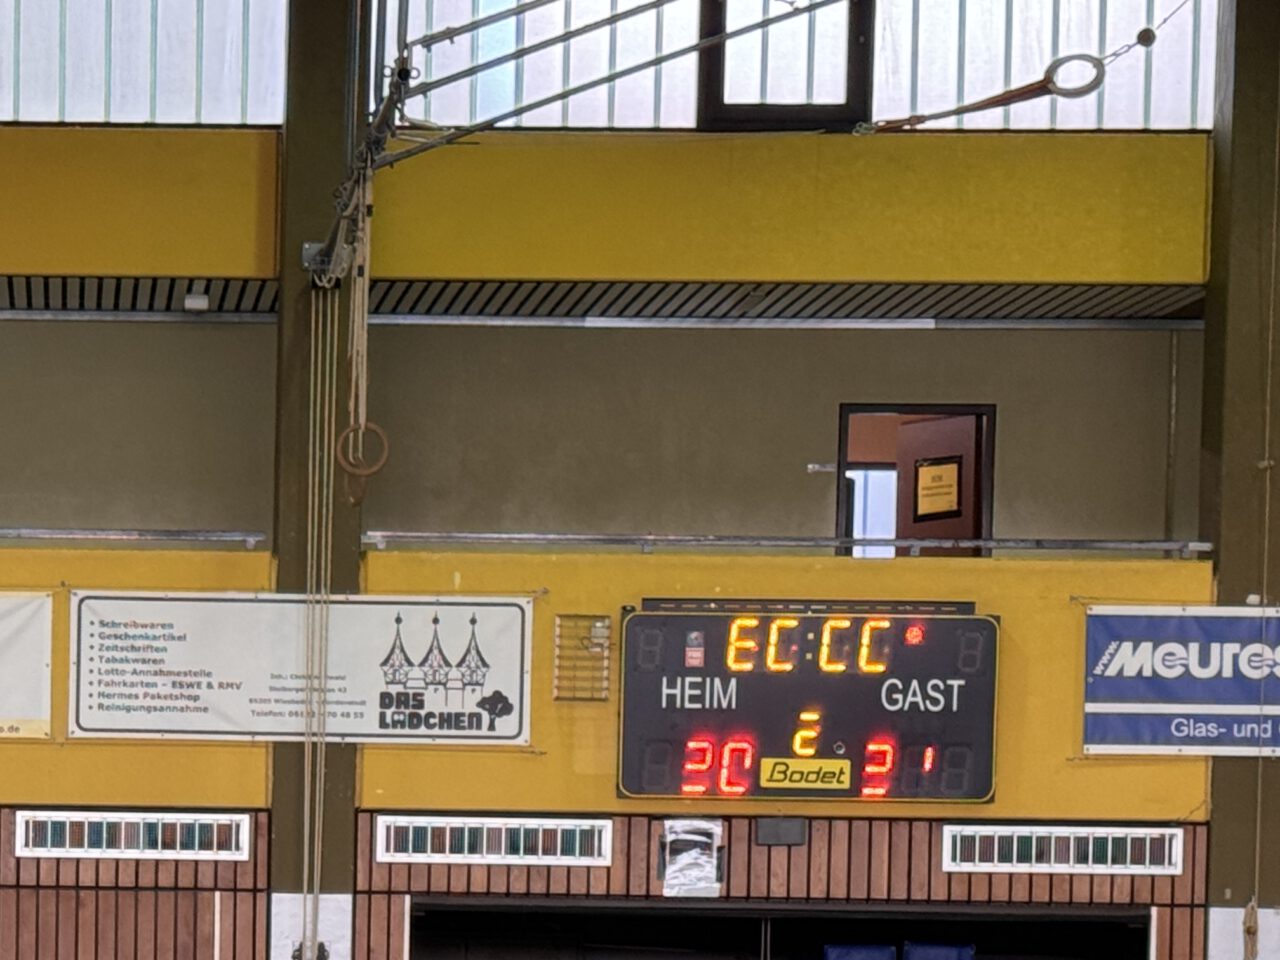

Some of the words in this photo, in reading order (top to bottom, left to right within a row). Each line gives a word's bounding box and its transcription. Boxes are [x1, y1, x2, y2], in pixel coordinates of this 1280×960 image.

[98, 620, 174, 630] Schreibwaren
[98, 631, 187, 642] Geschenkartikel
[98, 643, 168, 654] Zeitschriften
[98, 655, 166, 666] Tabakwaren
[1103, 641, 1280, 680] Meure
[97, 667, 213, 678] Lotto-Annahmestelle
[97, 679, 158, 689] Fahrkarten
[171, 680, 203, 690] ESWE
[217, 681, 243, 691] RMV
[97, 691, 140, 701] Hermes
[142, 691, 201, 703] Paketshop
[661, 676, 738, 710] HEIM
[880, 678, 966, 712] GAST
[379, 691, 425, 710] DAS
[97, 702, 210, 714] Reinigungsannahme
[1170, 717, 1227, 737] Glas-
[1232, 719, 1272, 738] und
[766, 761, 846, 785] Bodet
